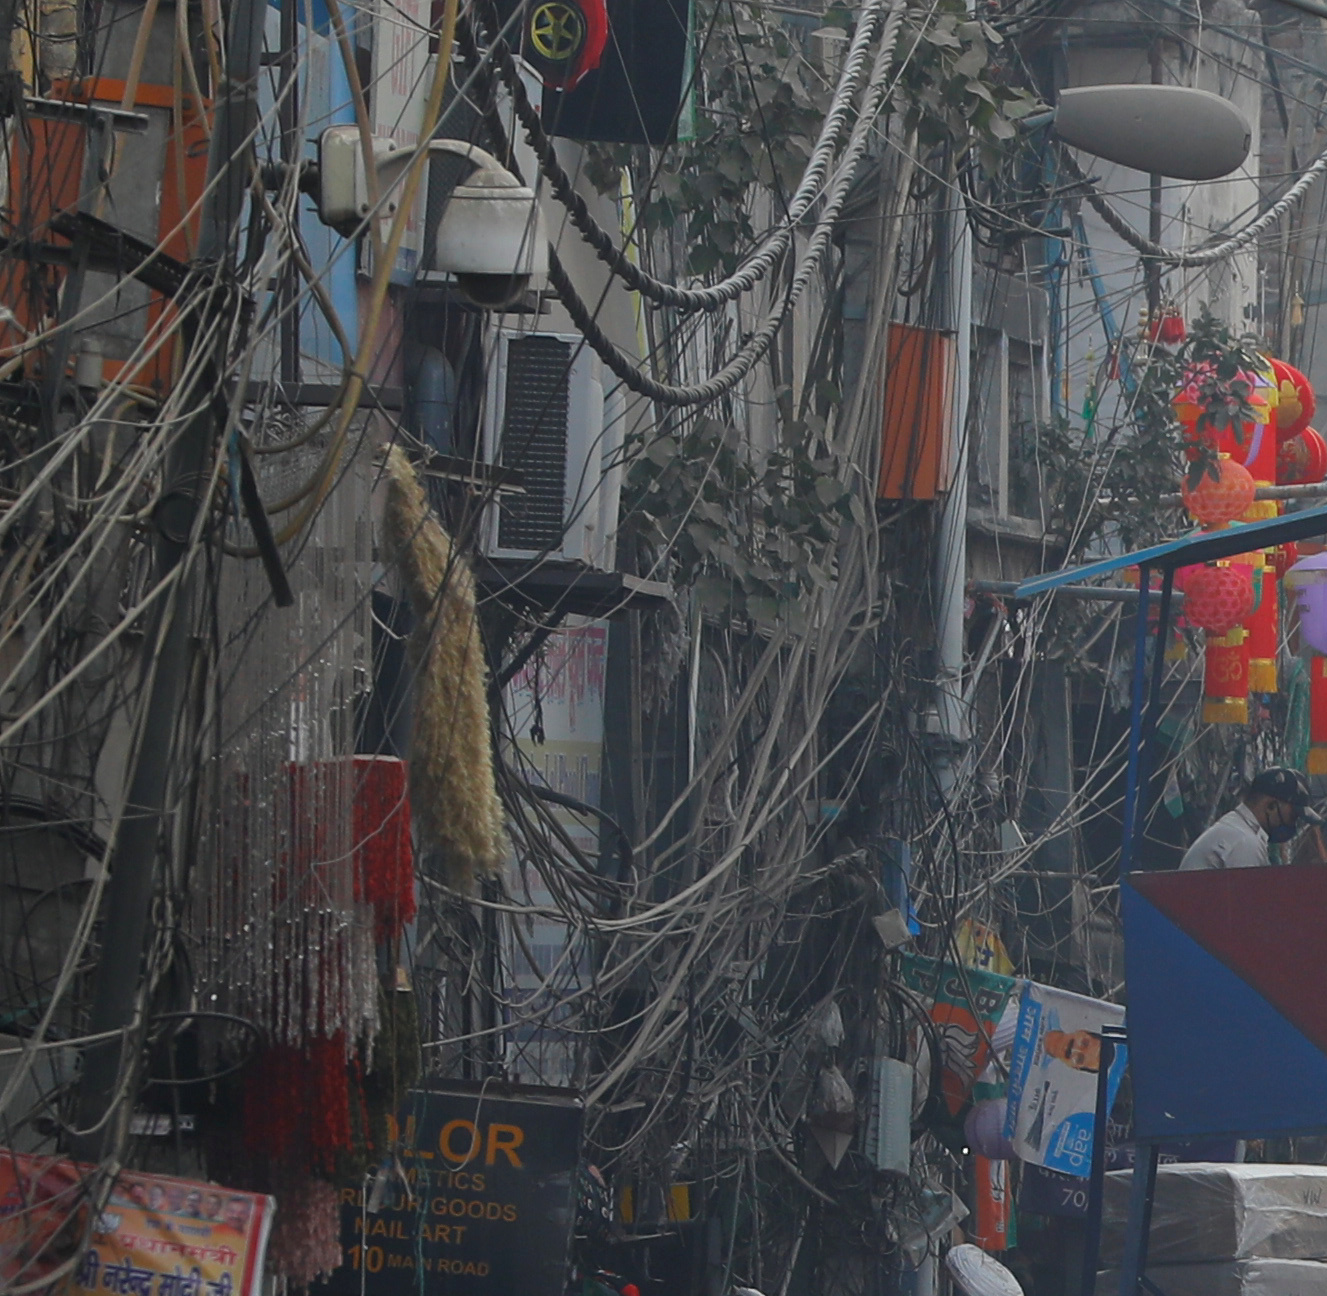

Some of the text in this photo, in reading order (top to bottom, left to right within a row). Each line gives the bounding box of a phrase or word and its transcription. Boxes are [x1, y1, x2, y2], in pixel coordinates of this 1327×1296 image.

[431, 1198, 518, 1222] GOODS
[354, 1217, 468, 1245] NAIL ART
[437, 1258, 490, 1277] ROAD
